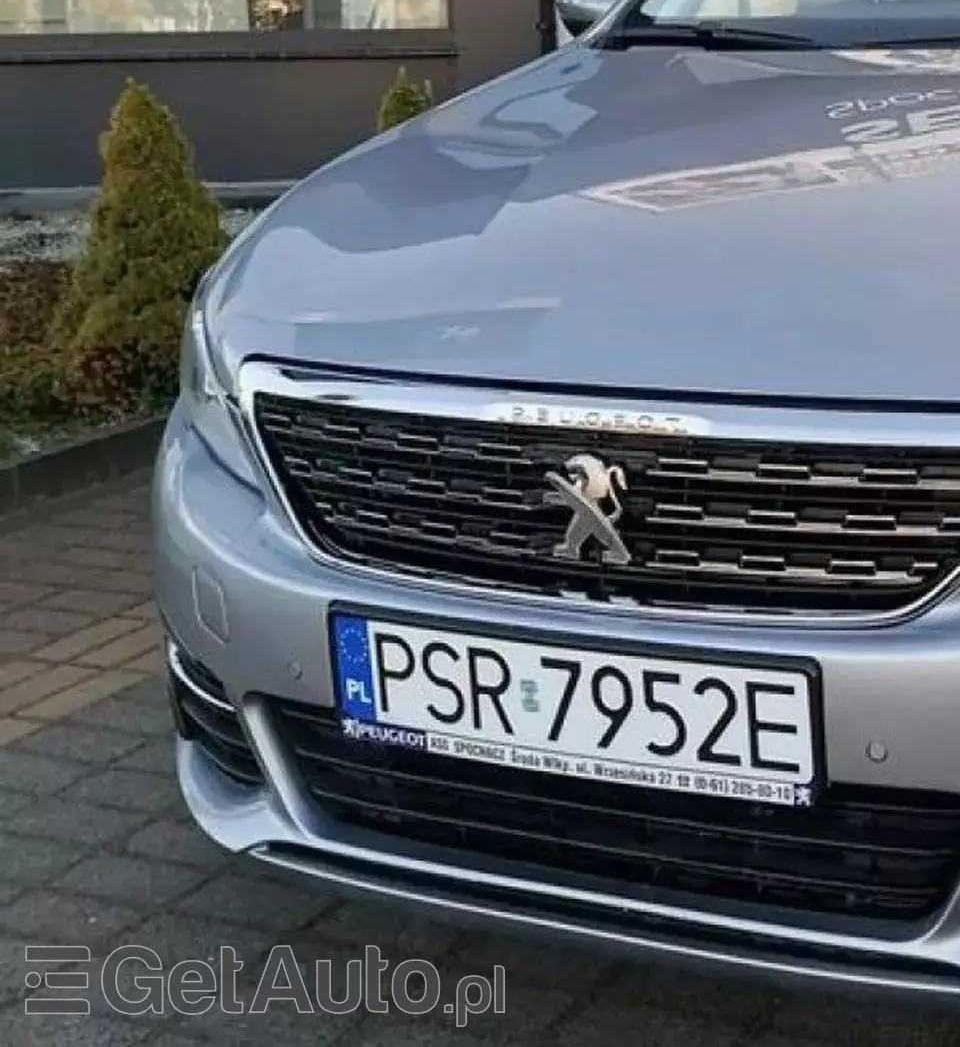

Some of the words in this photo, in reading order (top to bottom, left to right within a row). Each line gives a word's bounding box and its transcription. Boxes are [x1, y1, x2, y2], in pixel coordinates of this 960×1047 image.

[345, 678, 372, 704] PL
[374, 632, 514, 735] PSR
[540, 656, 801, 774] 7952E
